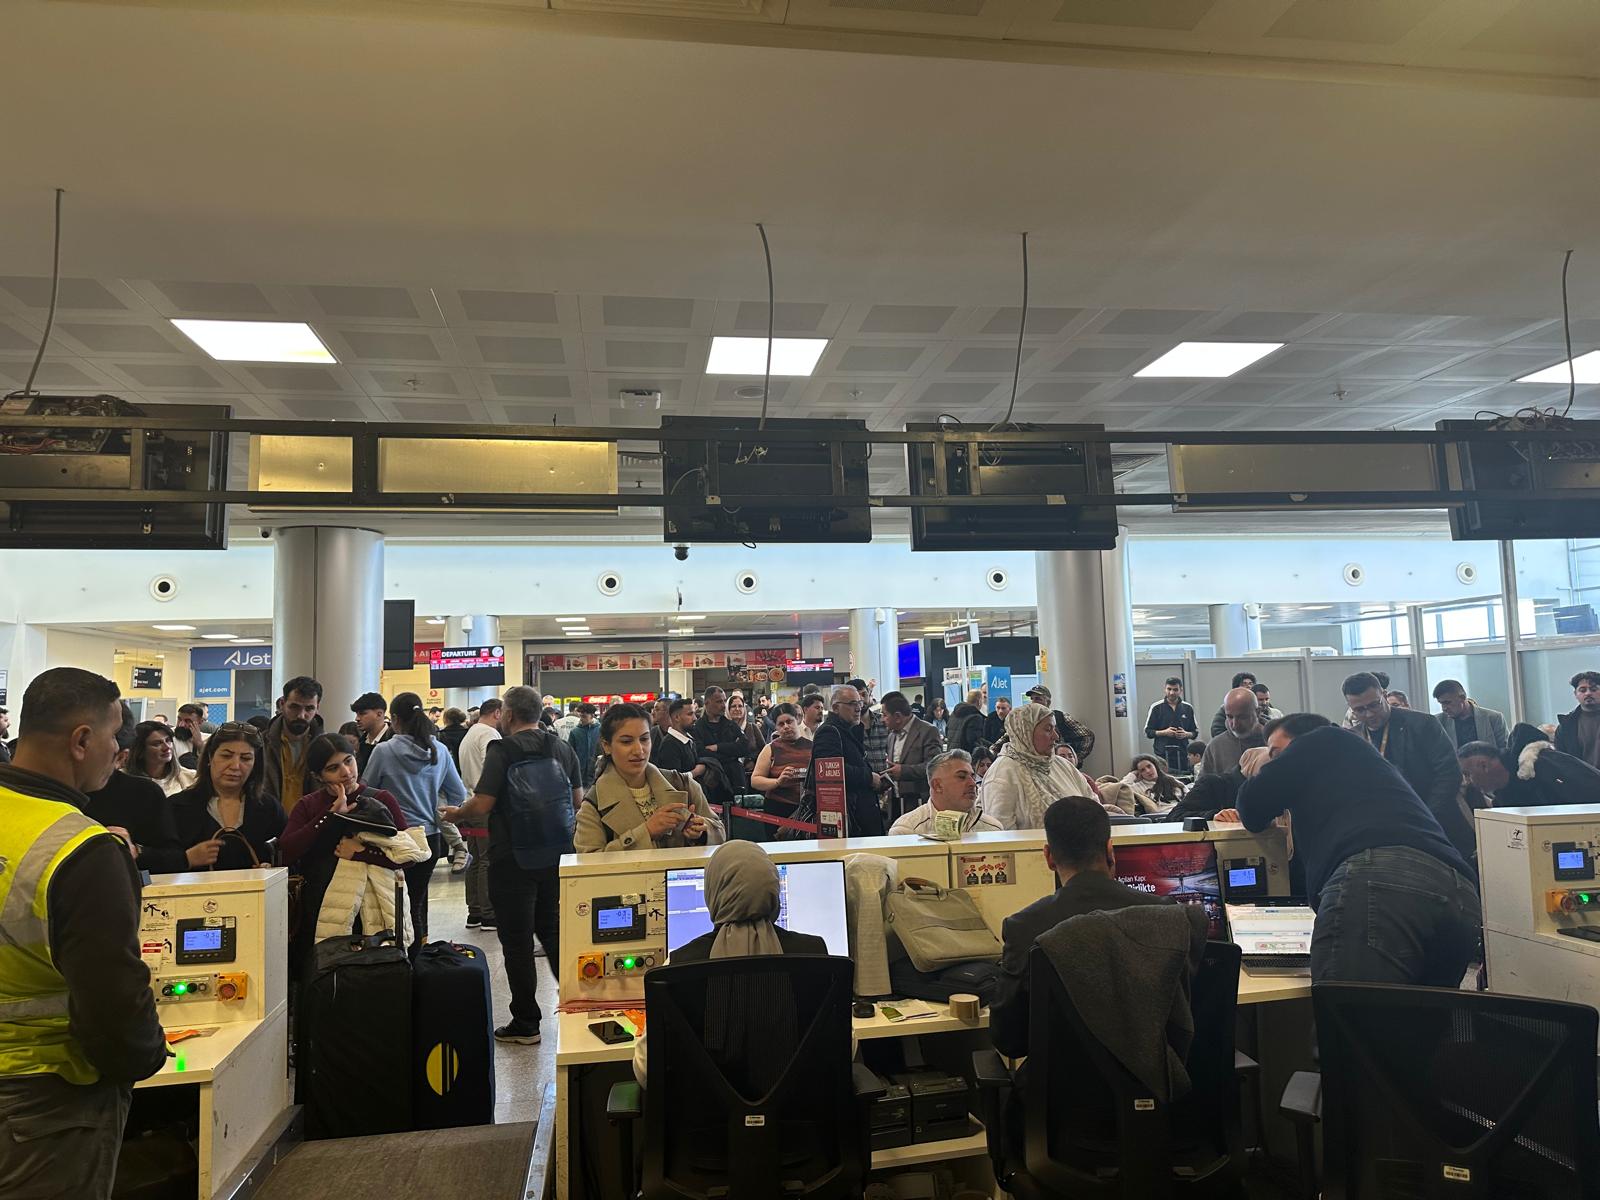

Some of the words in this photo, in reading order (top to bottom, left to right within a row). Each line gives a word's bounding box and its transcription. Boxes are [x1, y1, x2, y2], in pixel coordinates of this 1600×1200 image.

[224, 650, 271, 666] AJet
[441, 650, 476, 658] DEPARTURE
[991, 675, 1008, 689] AJet
[824, 761, 840, 769] TURKISH
